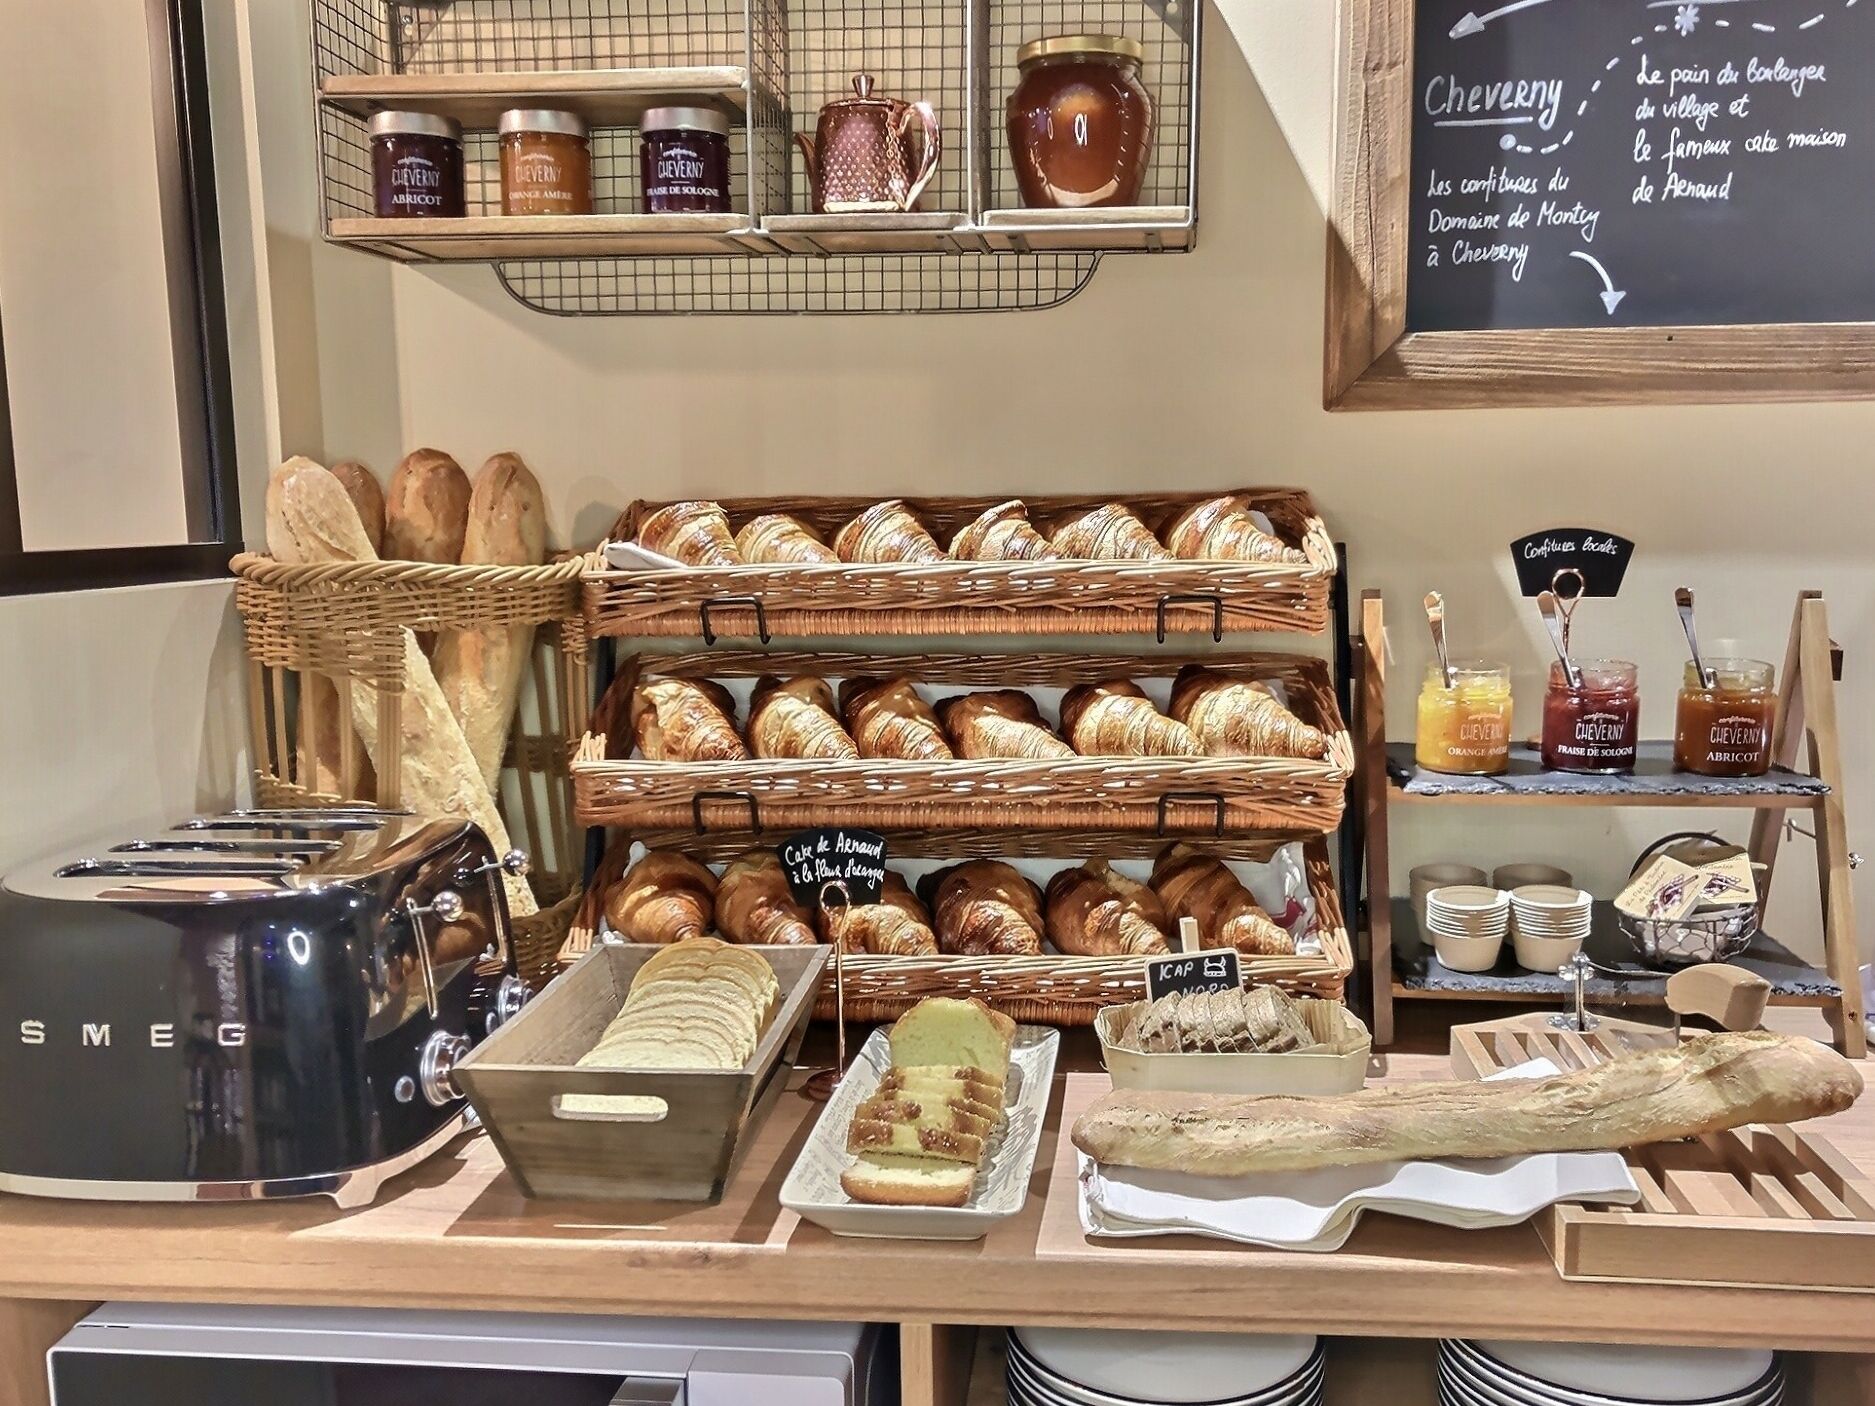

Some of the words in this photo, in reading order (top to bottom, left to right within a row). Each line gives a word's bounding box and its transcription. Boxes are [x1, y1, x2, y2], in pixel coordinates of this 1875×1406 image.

[1636, 53, 1664, 85] Le
[1669, 64, 1709, 97] pain
[1717, 61, 1739, 85] du
[1747, 57, 1826, 97] boulanger
[1424, 75, 1563, 131] Cheverny
[1635, 97, 1655, 120] du
[1663, 93, 1718, 131] village
[1728, 94, 1750, 117] et
[1634, 128, 1651, 163] le
[1661, 127, 1731, 174] fameux
[1745, 129, 1779, 152] cake
[1787, 128, 1847, 148] maison
[392, 168, 440, 187] CHEVERNY
[515, 165, 561, 183] CHEVERNY
[658, 160, 704, 178] CHEVERNY
[669, 186, 681, 195] DE
[1427, 168, 1452, 197] Les
[1460, 166, 1538, 202] confitures
[1548, 166, 1570, 192] du
[1632, 175, 1654, 204] de
[1661, 171, 1733, 201] Arnaud
[392, 194, 442, 205] ABRICOT
[1428, 209, 1500, 233] Domaine
[1507, 203, 1530, 228] de
[1537, 200, 1600, 243] Montcy
[1452, 240, 1528, 282] Cheverny
[1575, 723, 1624, 740] CHEVERNY
[1710, 727, 1760, 744] CHEVERNY
[1448, 747, 1486, 756] ORANGE
[1558, 745, 1585, 756] FRAISE
[1587, 748, 1599, 756] DE
[1706, 751, 1759, 762] ABRICOT
[785, 844, 814, 866] Cake
[817, 835, 831, 853] de
[835, 831, 883, 859] Arnaud
[802, 863, 814, 883] la
[20, 1019, 247, 1048] SMEG
